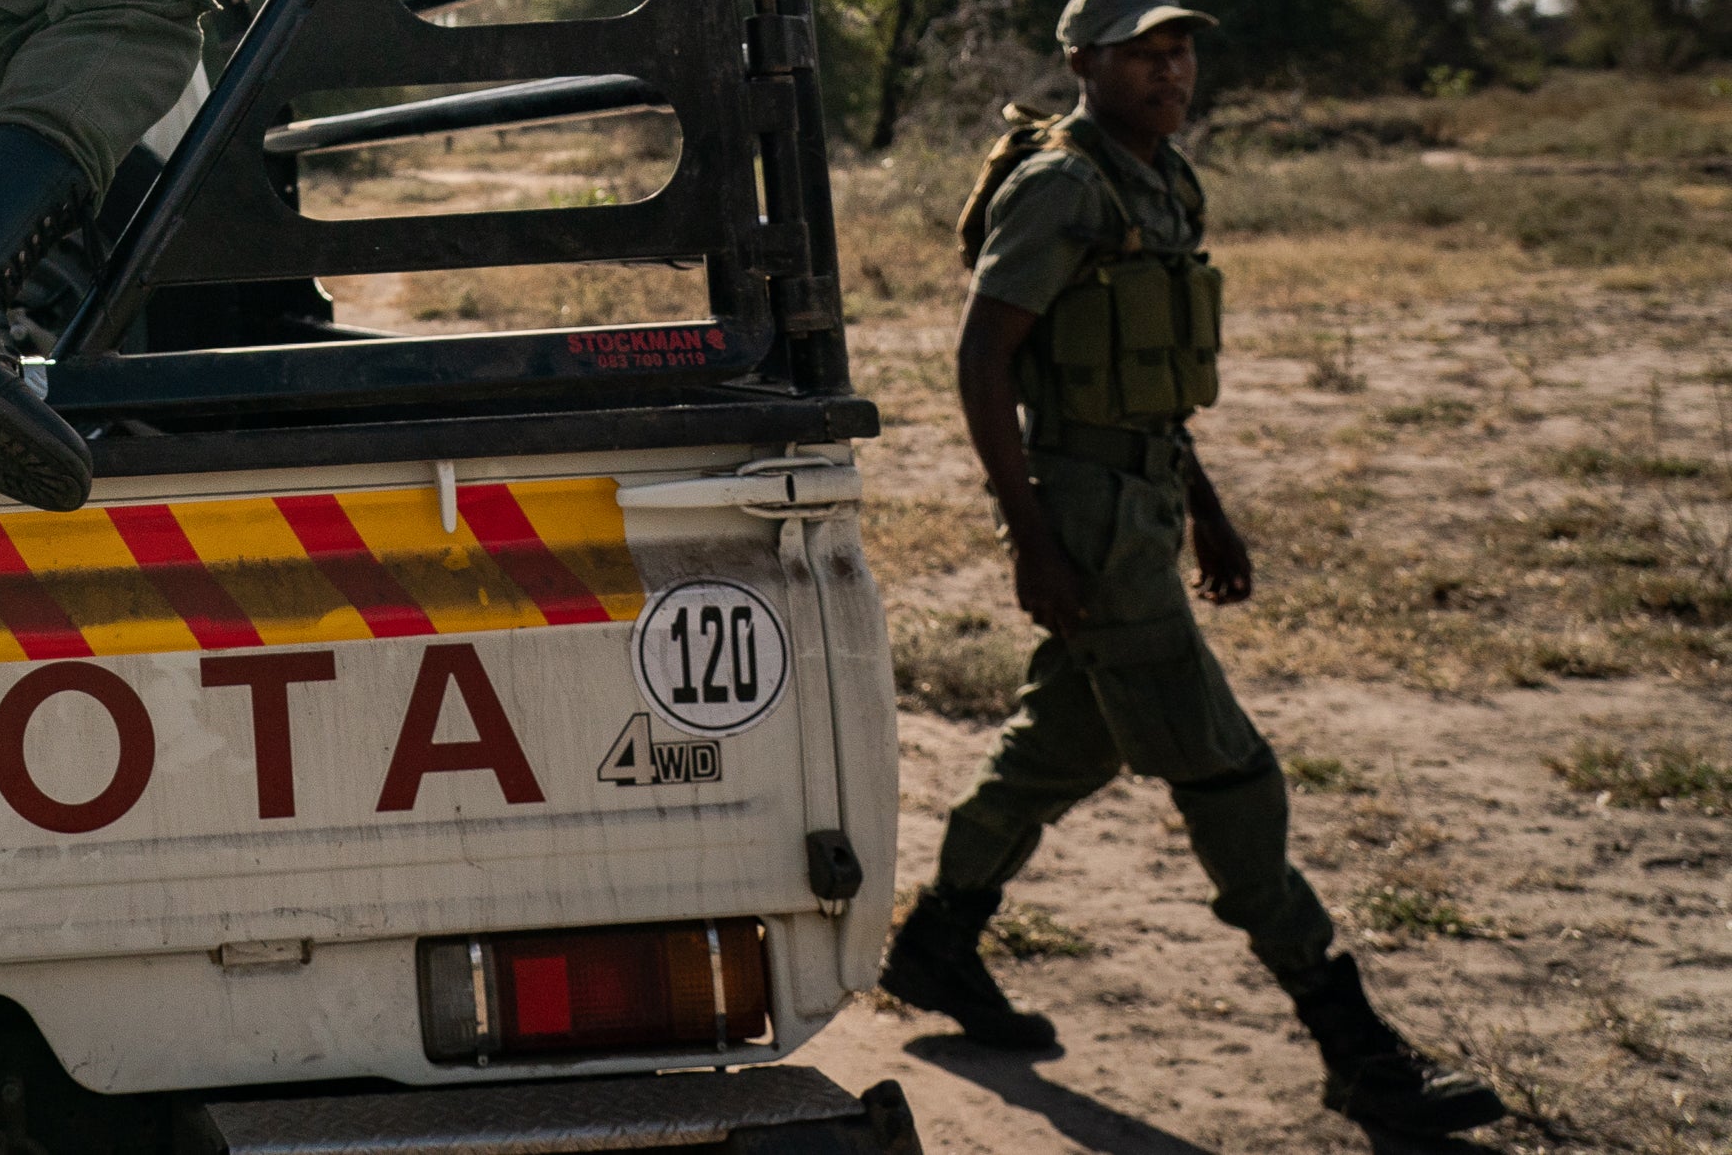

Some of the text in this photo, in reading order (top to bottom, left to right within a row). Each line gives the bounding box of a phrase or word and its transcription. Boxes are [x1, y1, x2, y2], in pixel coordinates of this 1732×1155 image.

[568, 329, 703, 354] STOCKMAN
[671, 606, 758, 704] 120
[597, 712, 722, 787] 4WD
